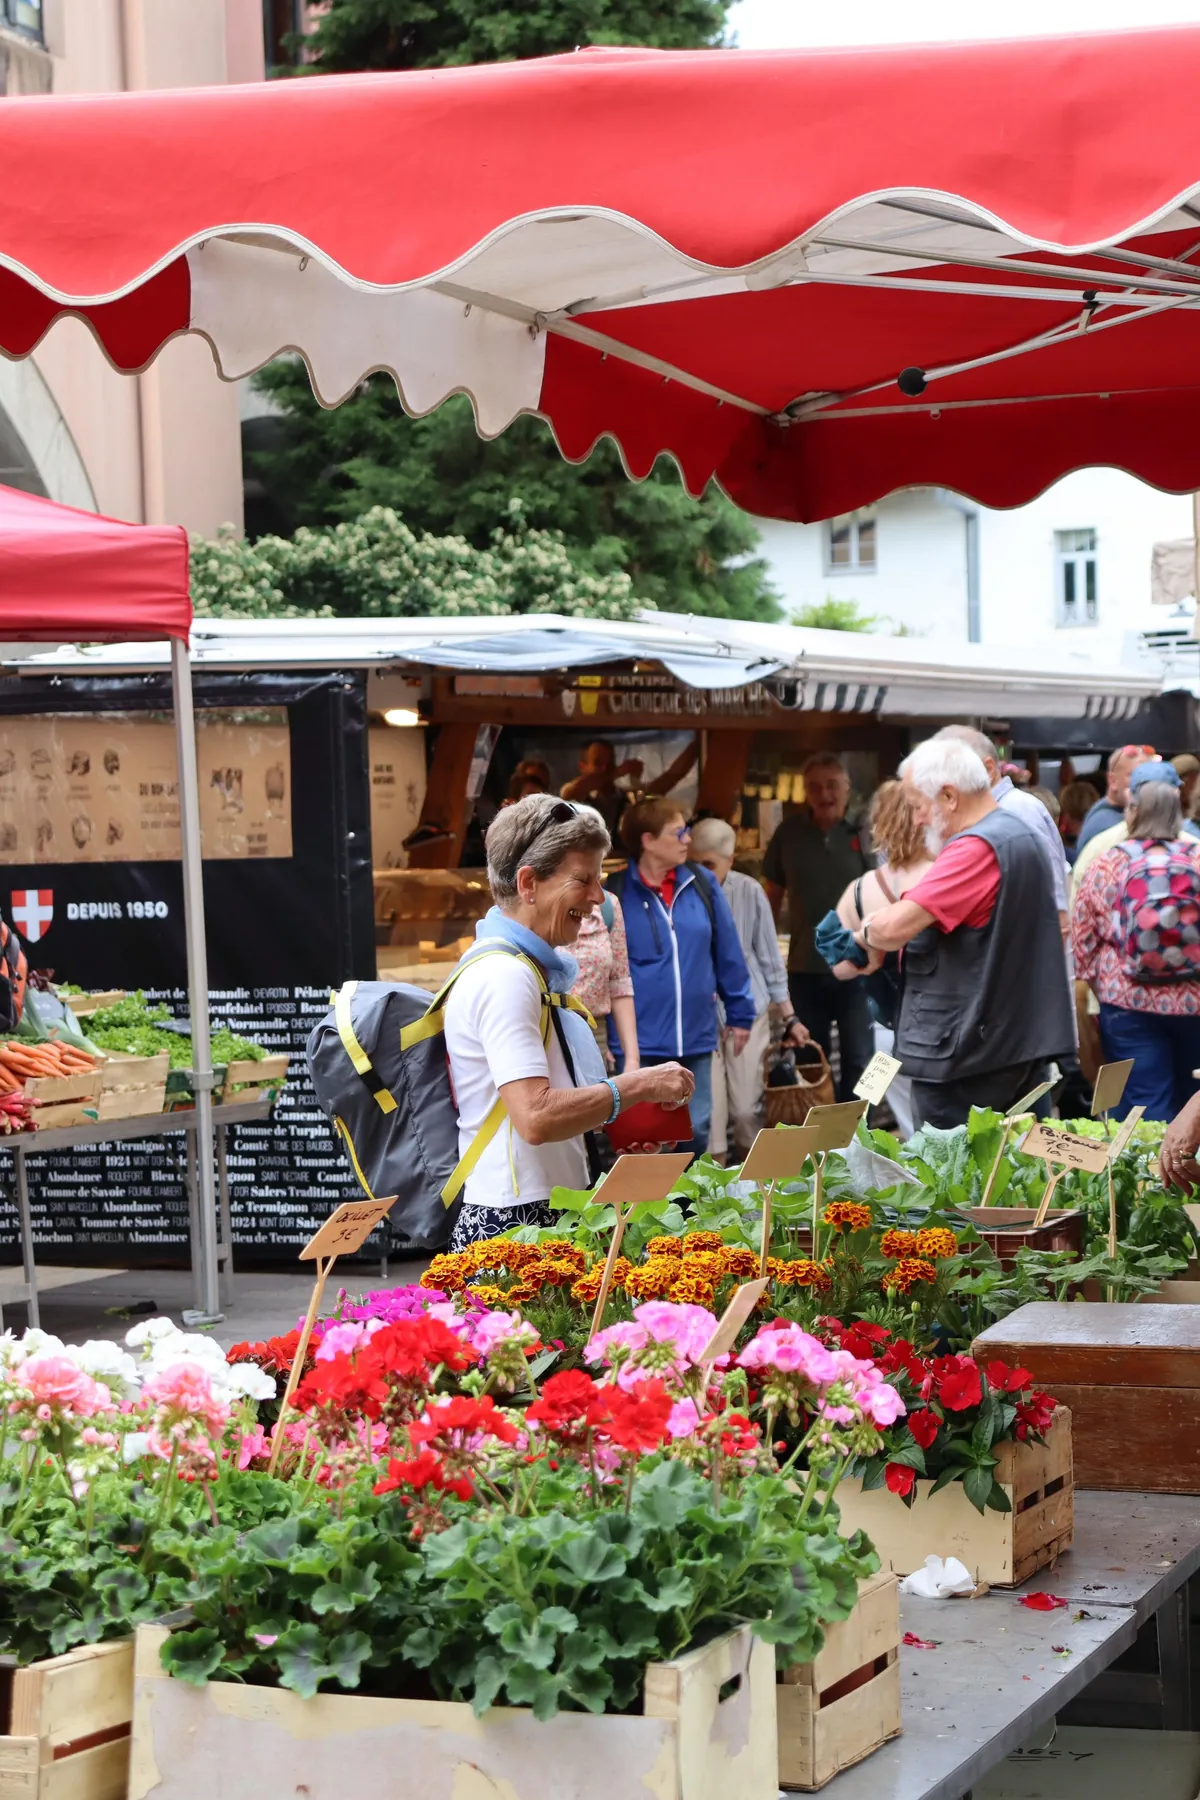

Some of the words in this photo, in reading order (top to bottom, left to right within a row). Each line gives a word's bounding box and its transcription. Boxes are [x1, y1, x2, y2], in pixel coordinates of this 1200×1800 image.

[67, 902, 122, 920] DEPUIS
[127, 901, 169, 919] 1950
[173, 986, 186, 999] de
[212, 1017, 226, 1029] de
[228, 1018, 289, 1029] Normandie
[234, 1124, 273, 1136] Tomme
[274, 1124, 287, 1136] de
[288, 1125, 330, 1139] Turpin
[99, 1141, 113, 1153] de
[234, 1140, 269, 1152] Comté
[105, 1155, 130, 1168] 1924
[294, 1155, 335, 1168] Tomme
[47, 1171, 102, 1182] Abondance
[151, 1171, 175, 1182] Bleu
[317, 1170, 354, 1183] Comté
[40, 1187, 76, 1198] Tomme
[78, 1186, 90, 1198] de
[91, 1186, 126, 1198] Savoie
[251, 1186, 286, 1198] Salers
[288, 1186, 340, 1198] Tradition
[102, 1201, 162, 1213] Abondance
[230, 1200, 244, 1213] de
[247, 1201, 308, 1216] Termignon
[80, 1217, 118, 1229] Tomme
[120, 1216, 132, 1228] de
[134, 1216, 170, 1228] Savoie
[231, 1217, 256, 1228] 1924
[127, 1231, 188, 1243] Abondance
[254, 1231, 267, 1244] de
